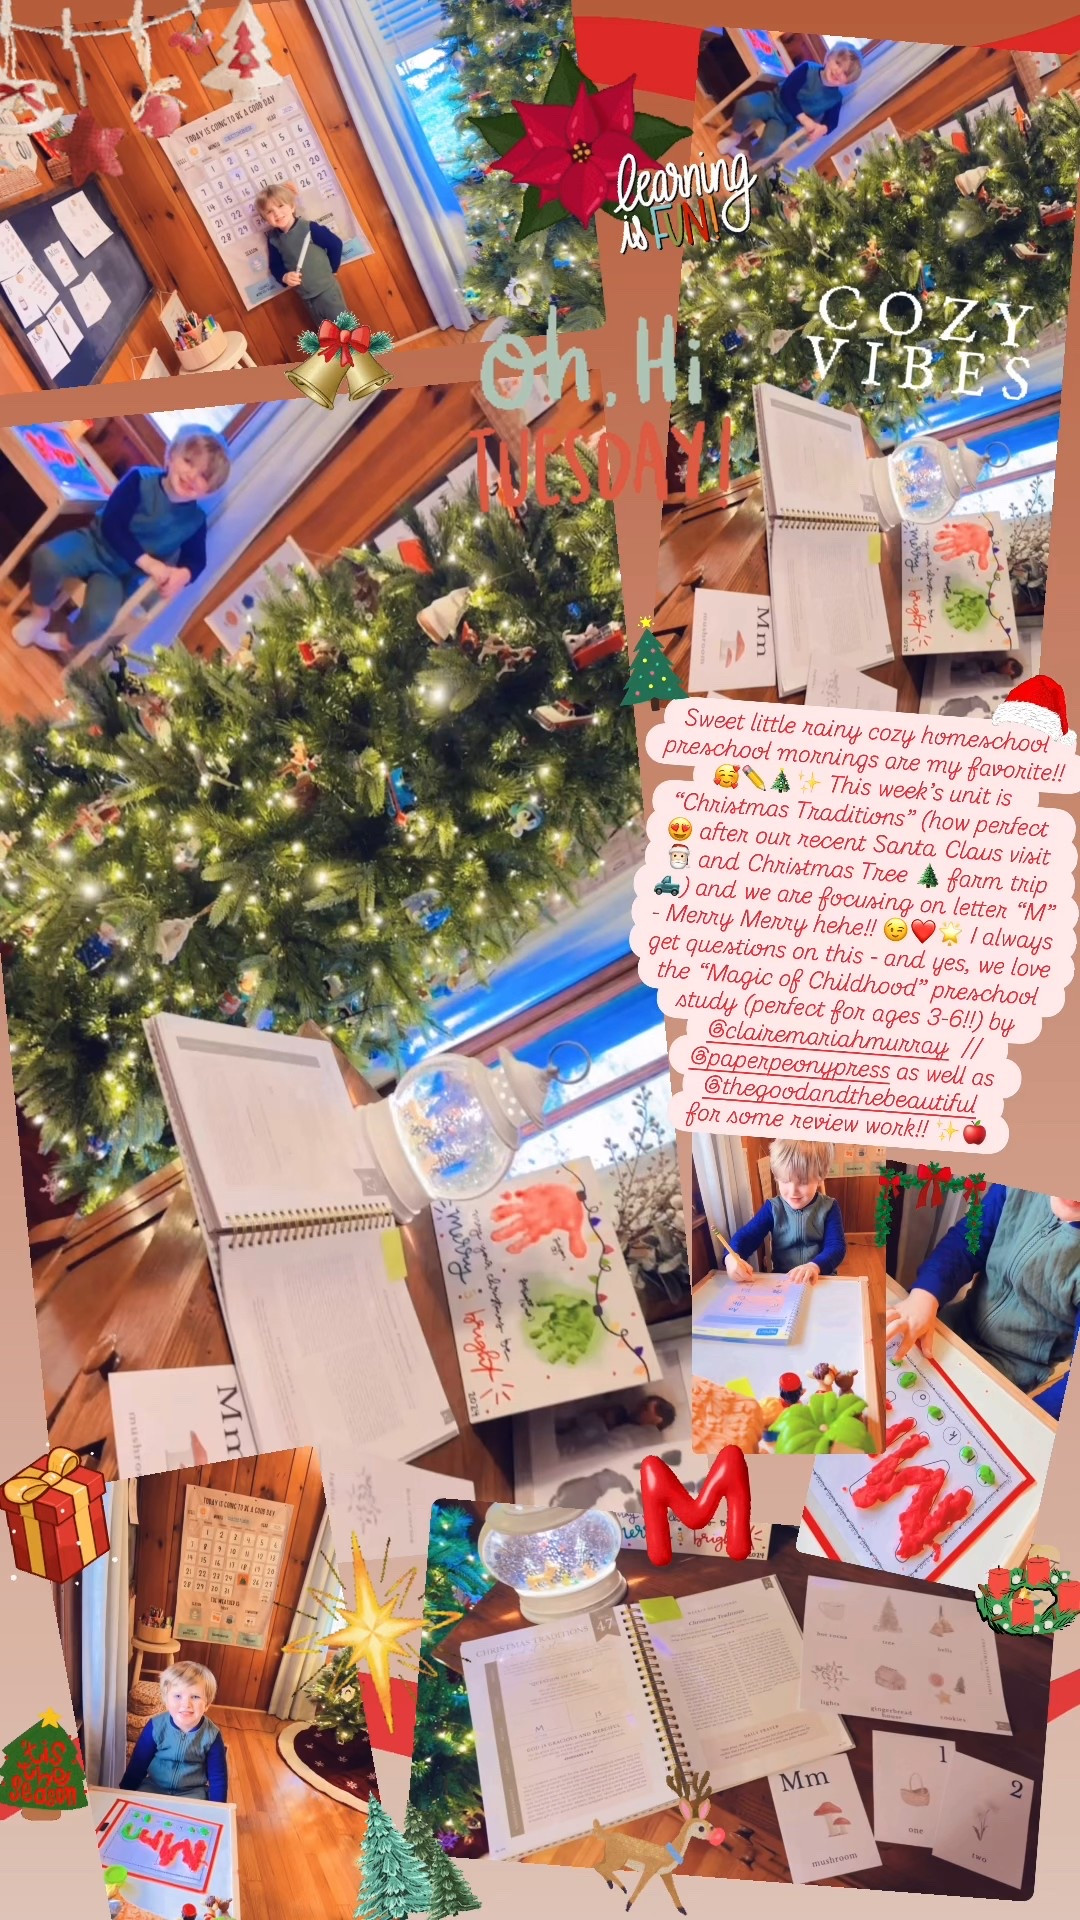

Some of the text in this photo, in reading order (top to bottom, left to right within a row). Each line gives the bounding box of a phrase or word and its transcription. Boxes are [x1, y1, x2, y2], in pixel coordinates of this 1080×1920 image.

[250, 139, 312, 174] 10 11 12 13
[206, 203, 216, 213] 14
[223, 195, 233, 205] 15
[241, 188, 250, 197] 16
[274, 171, 284, 181] 18
[292, 163, 301, 173] 19
[308, 154, 320, 165] 20
[214, 170, 328, 228] 21 22 26 27
[220, 225, 249, 244] 28 29
[756, 606, 771, 657] Mm
[596, 1616, 614, 1633] 47
[820, 1699, 841, 1708] lights
[938, 1745, 948, 1763] 1
[778, 1769, 831, 1793] Mm
[1009, 1779, 1024, 1799] 2
[908, 1826, 924, 1835] one
[811, 1851, 859, 1868] mushroom
[971, 1851, 988, 1863] two
